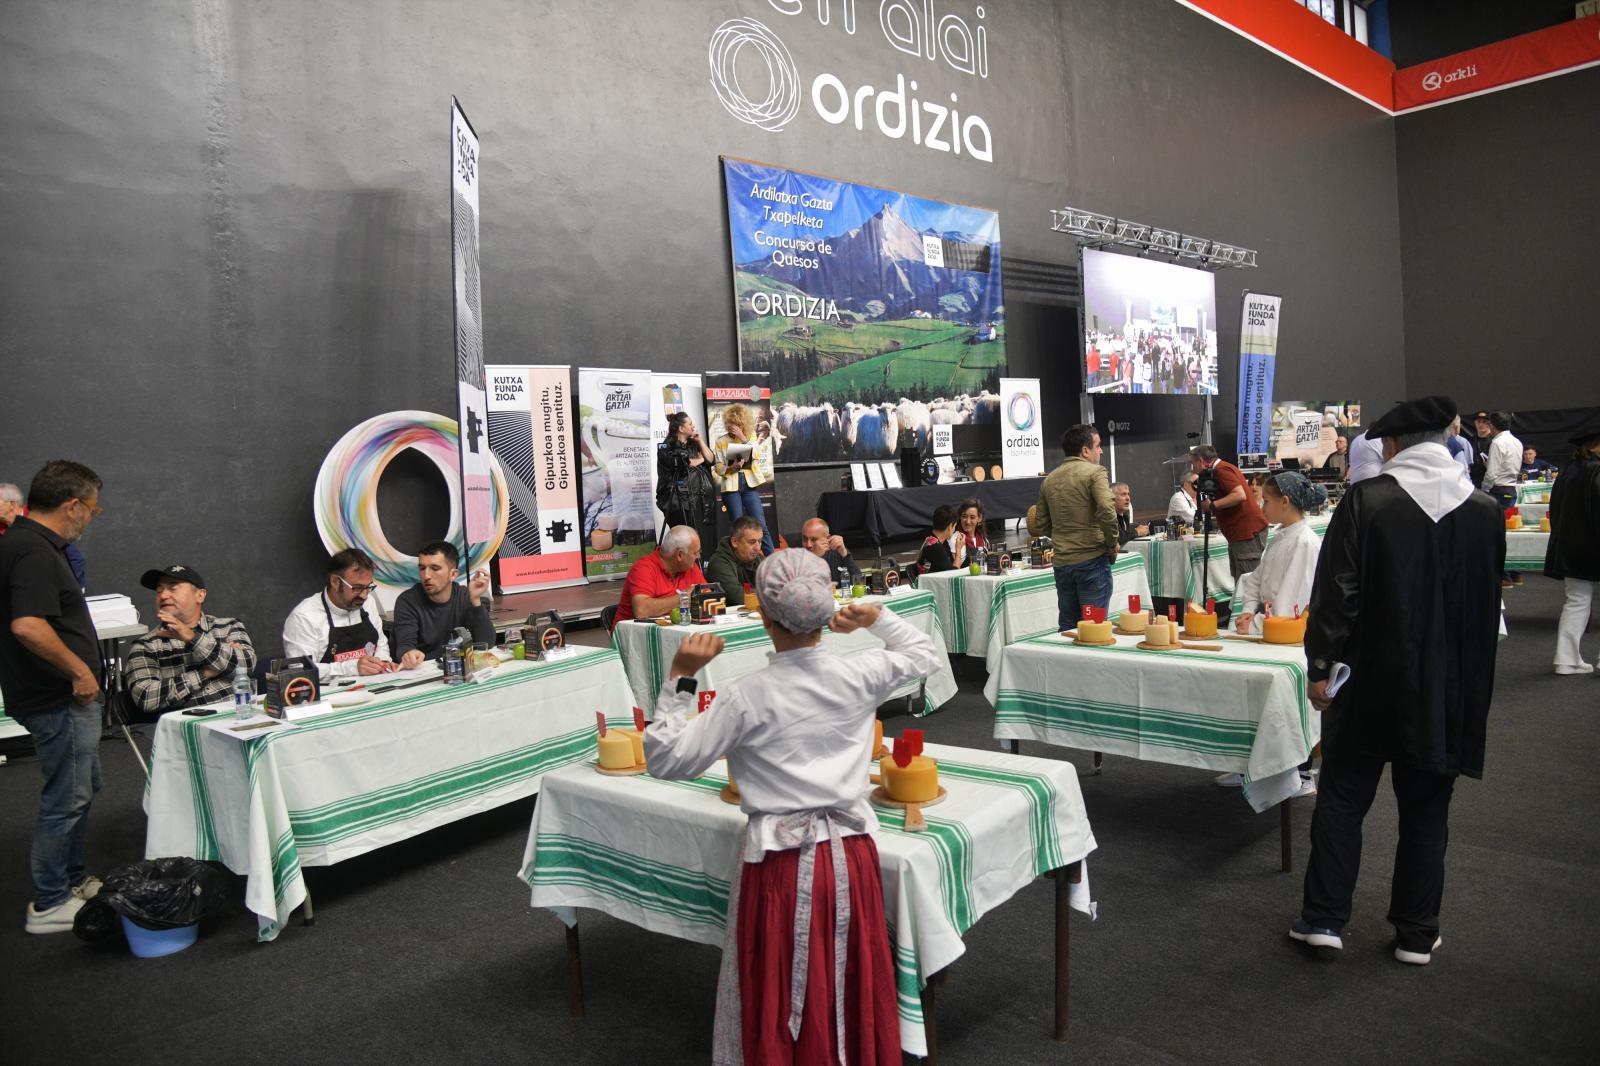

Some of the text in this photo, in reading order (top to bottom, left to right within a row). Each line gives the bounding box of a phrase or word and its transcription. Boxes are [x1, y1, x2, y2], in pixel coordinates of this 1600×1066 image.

[1444, 65, 1478, 83] orkli
[812, 73, 993, 162] ordizia
[750, 183, 833, 211] Ardilatxa Gazta
[763, 205, 824, 229] Txapelketa
[754, 231, 833, 255] Concurso de
[772, 250, 819, 269] Quesos
[752, 292, 841, 321] ORDIZIA
[1249, 302, 1276, 311] KUTXA
[1248, 310, 1275, 320] FUNDA
[494, 376, 523, 385] KUTXA
[495, 385, 524, 393] FUNDA
[712, 389, 749, 398] IDIAZABAL
[495, 393, 516, 401] ZIOA
[606, 393, 632, 402] ARTZAI
[605, 401, 630, 411] GAZTA
[1296, 424, 1320, 434] ARTZAI
[541, 387, 557, 491] Gipuzkoa mugitu,
[553, 382, 569, 490] Gipuzkoa sentituz.
[1006, 434, 1040, 448] ordizia
[1295, 432, 1319, 444] GAZTA
[1085, 606, 1092, 616] 5
